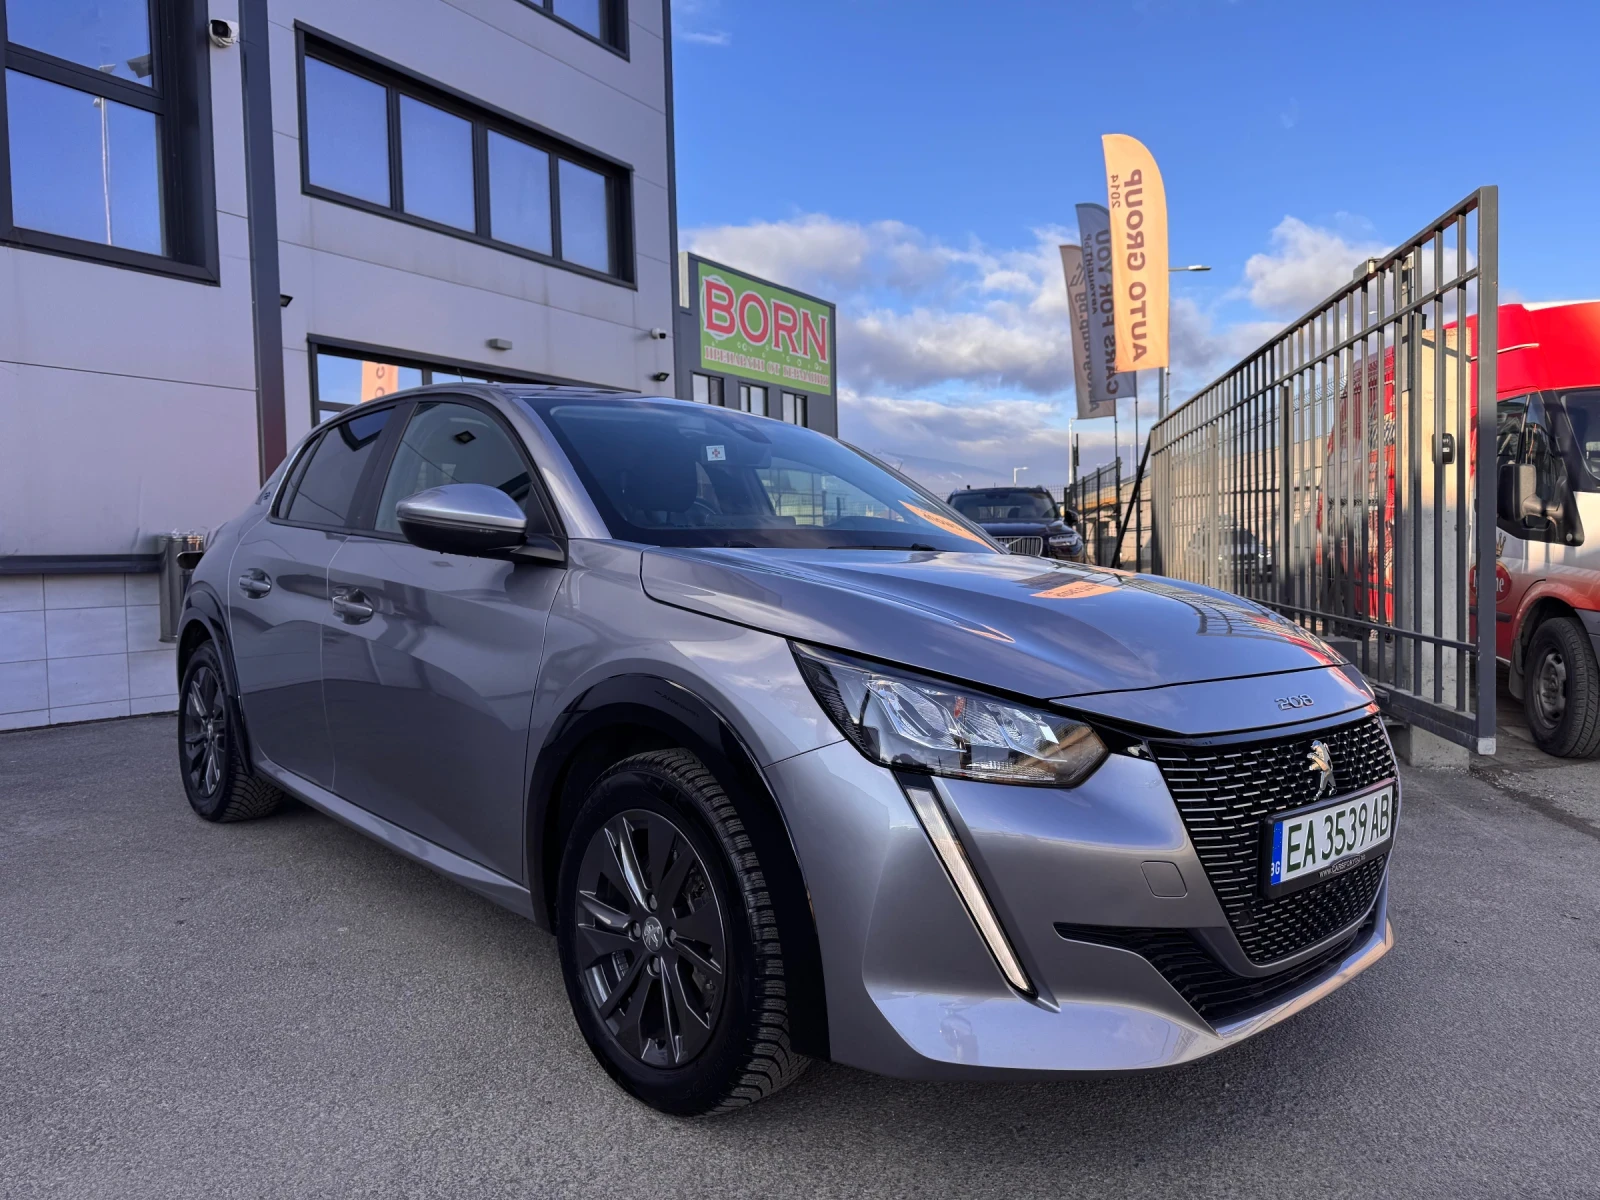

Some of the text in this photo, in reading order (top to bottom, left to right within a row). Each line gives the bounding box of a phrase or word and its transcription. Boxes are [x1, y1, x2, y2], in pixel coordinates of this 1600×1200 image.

[702, 276, 828, 364] BORN
[1274, 694, 1314, 711] 208
[1287, 794, 1389, 873] EA 3539 AB
